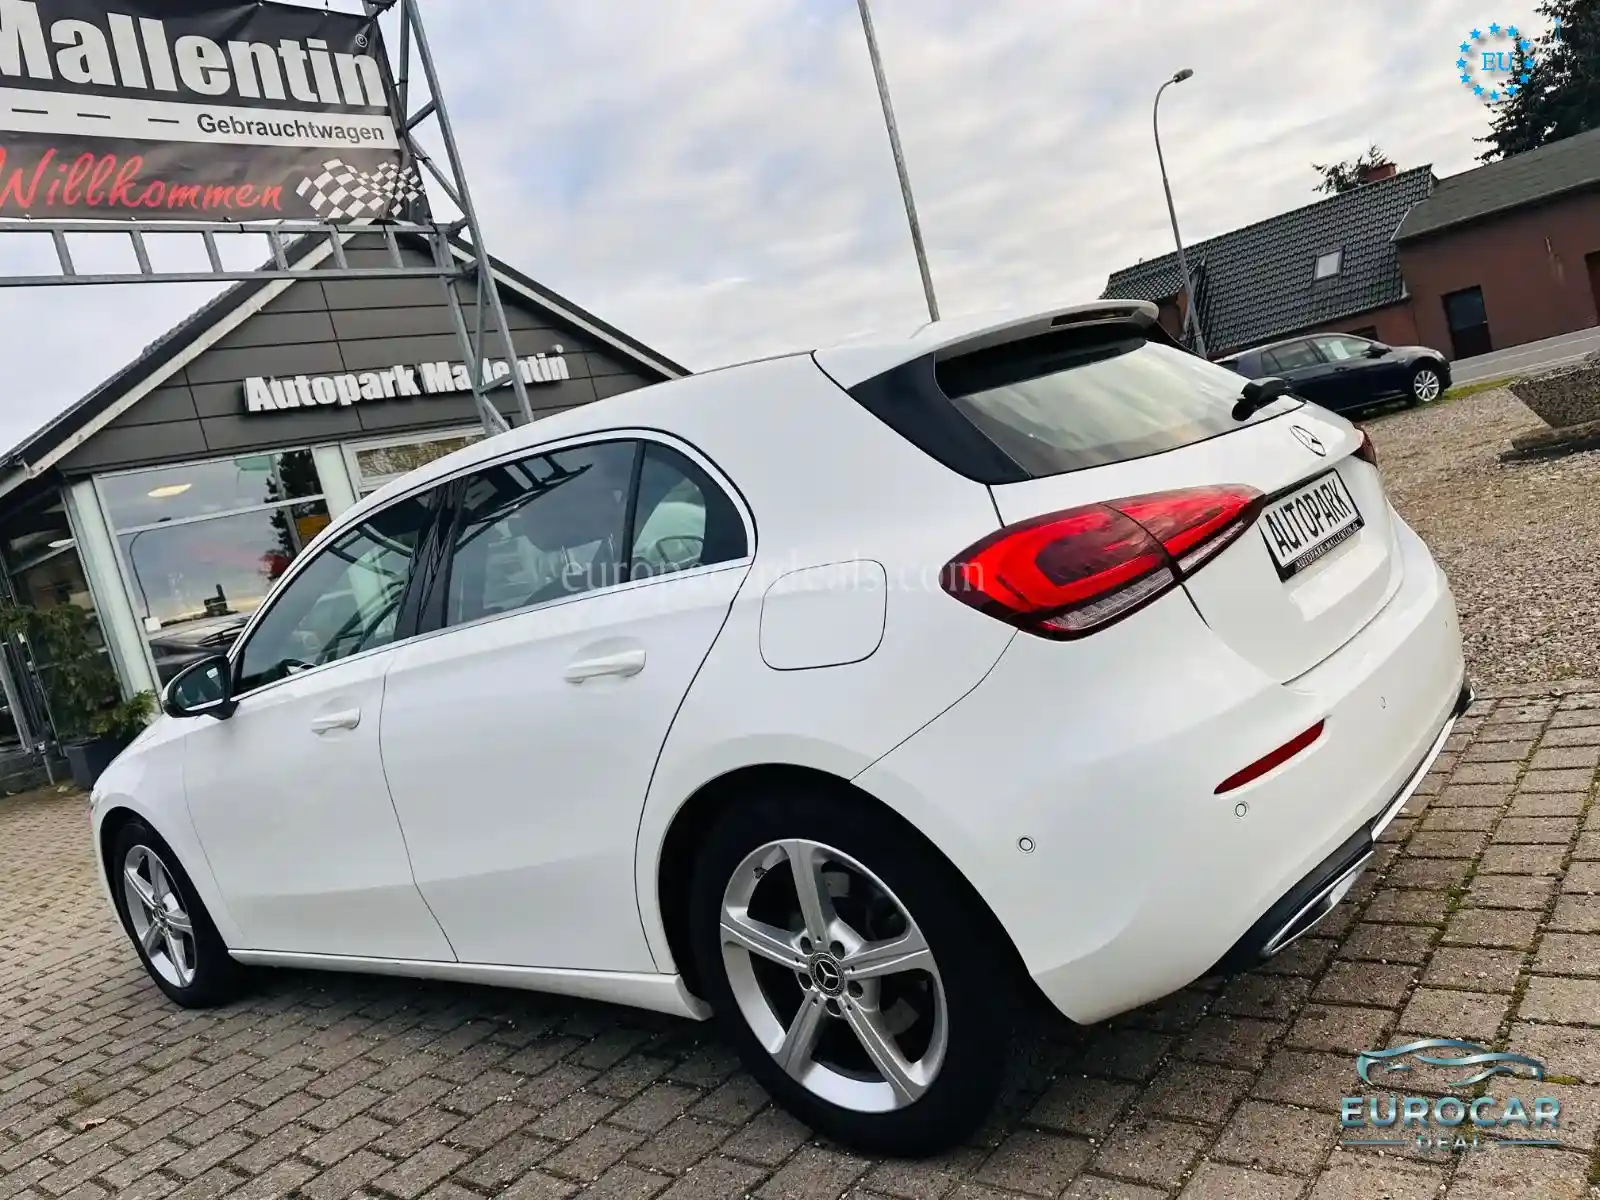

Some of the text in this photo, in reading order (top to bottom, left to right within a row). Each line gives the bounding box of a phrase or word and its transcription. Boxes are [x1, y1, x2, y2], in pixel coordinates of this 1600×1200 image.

[0, 0, 388, 107] Mallentin
[197, 114, 384, 142] Gebrauchtwagen
[0, 146, 283, 212] Willkommen
[244, 353, 570, 412] Autopark Malentin
[1265, 478, 1352, 557] AUTOPARK
